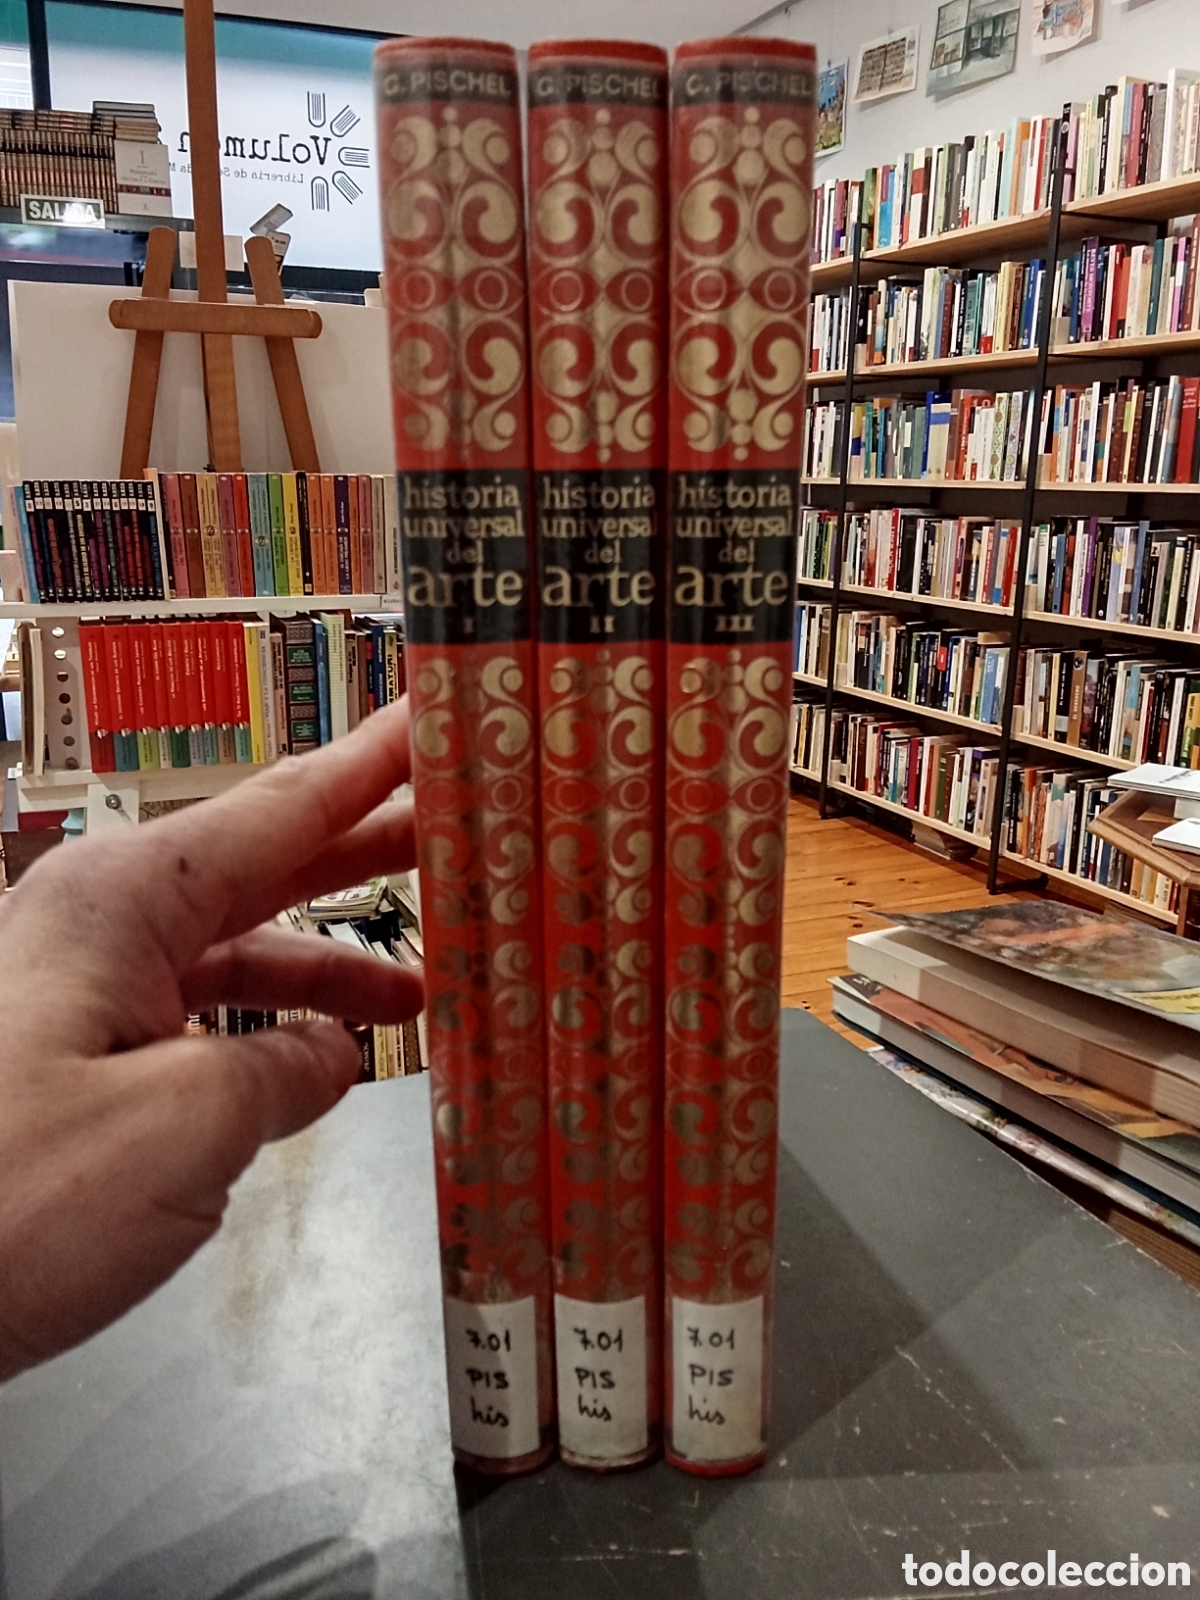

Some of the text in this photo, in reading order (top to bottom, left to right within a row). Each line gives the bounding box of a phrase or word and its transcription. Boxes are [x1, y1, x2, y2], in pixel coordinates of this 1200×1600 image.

[384, 69, 512, 98] G. PISCHEL
[537, 73, 559, 97] G.
[686, 69, 813, 96] G. PISCHEL
[406, 475, 520, 509] historia
[543, 475, 656, 510] historia
[679, 475, 792, 509] historia
[405, 509, 525, 539] universal
[676, 509, 794, 538] universal
[447, 537, 484, 564] del
[584, 541, 622, 564] del
[718, 539, 756, 564] del
[407, 565, 524, 608] arte
[542, 564, 656, 607] arte
[674, 564, 789, 607] arte
[466, 1328, 511, 1351] 7.01
[574, 1327, 624, 1352] 7.01
[687, 1326, 735, 1350] 7.01
[466, 1368, 509, 1390] PIS
[574, 1366, 615, 1390] PIS
[687, 1363, 735, 1387] PIS
[470, 1396, 509, 1428] his
[577, 1394, 612, 1422] his
[688, 1394, 726, 1426] his
